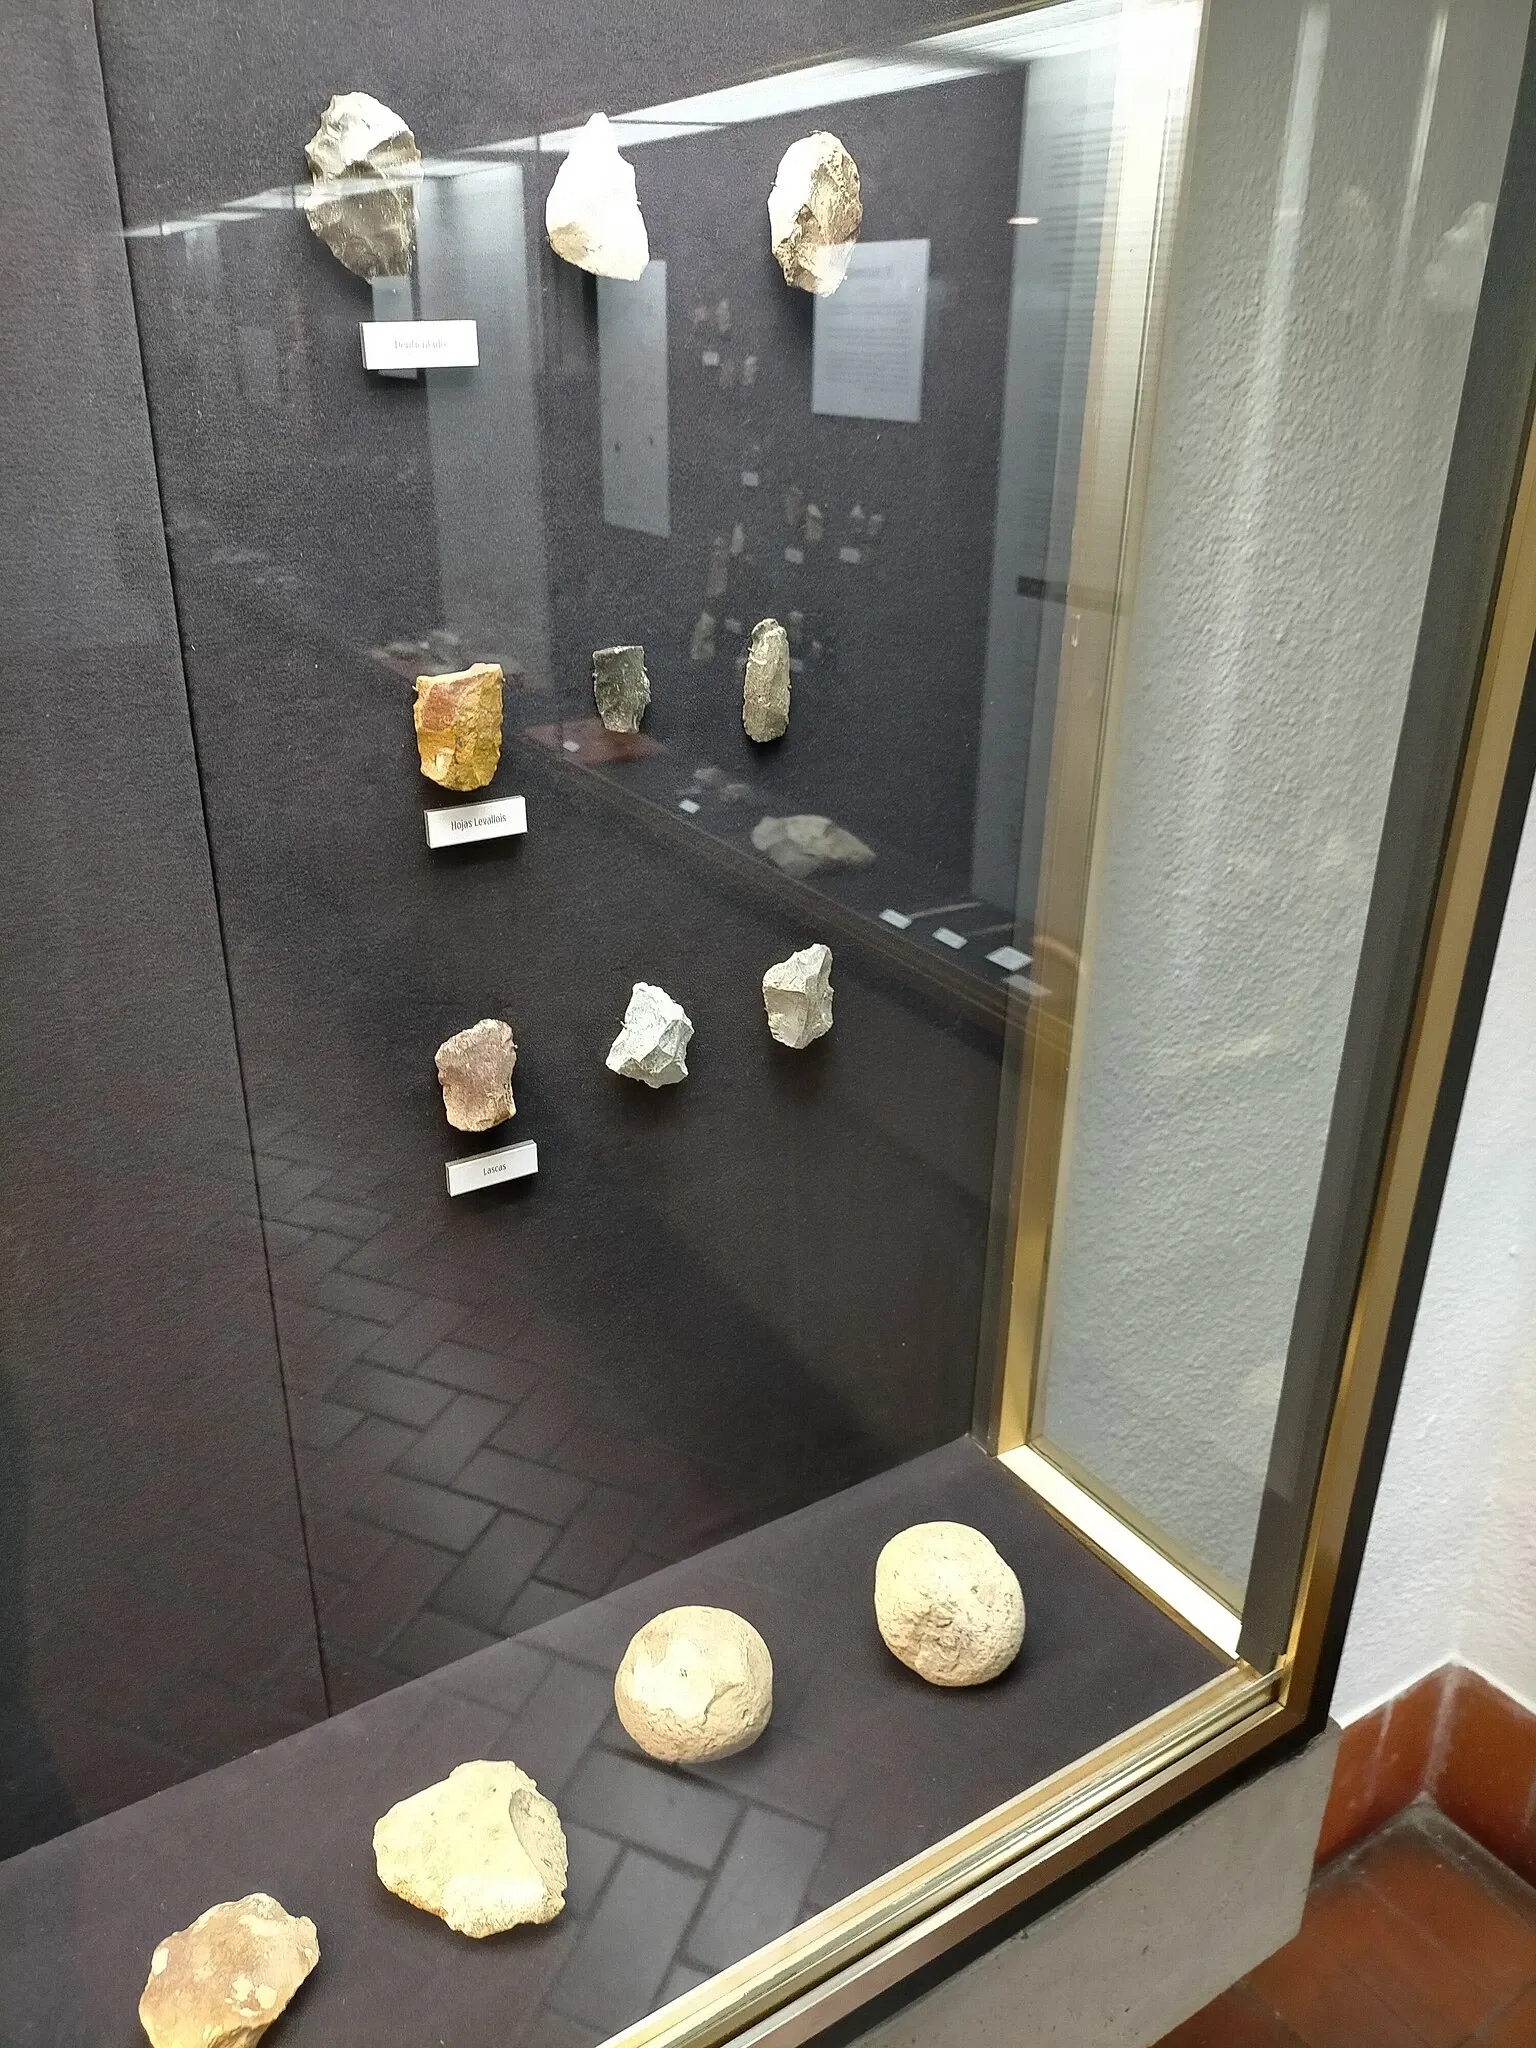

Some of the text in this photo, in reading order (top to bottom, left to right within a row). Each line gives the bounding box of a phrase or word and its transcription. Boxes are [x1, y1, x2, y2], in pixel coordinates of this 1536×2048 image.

[451, 813, 507, 831] Hojas Levallois
[483, 1163, 507, 1176] Lascas
